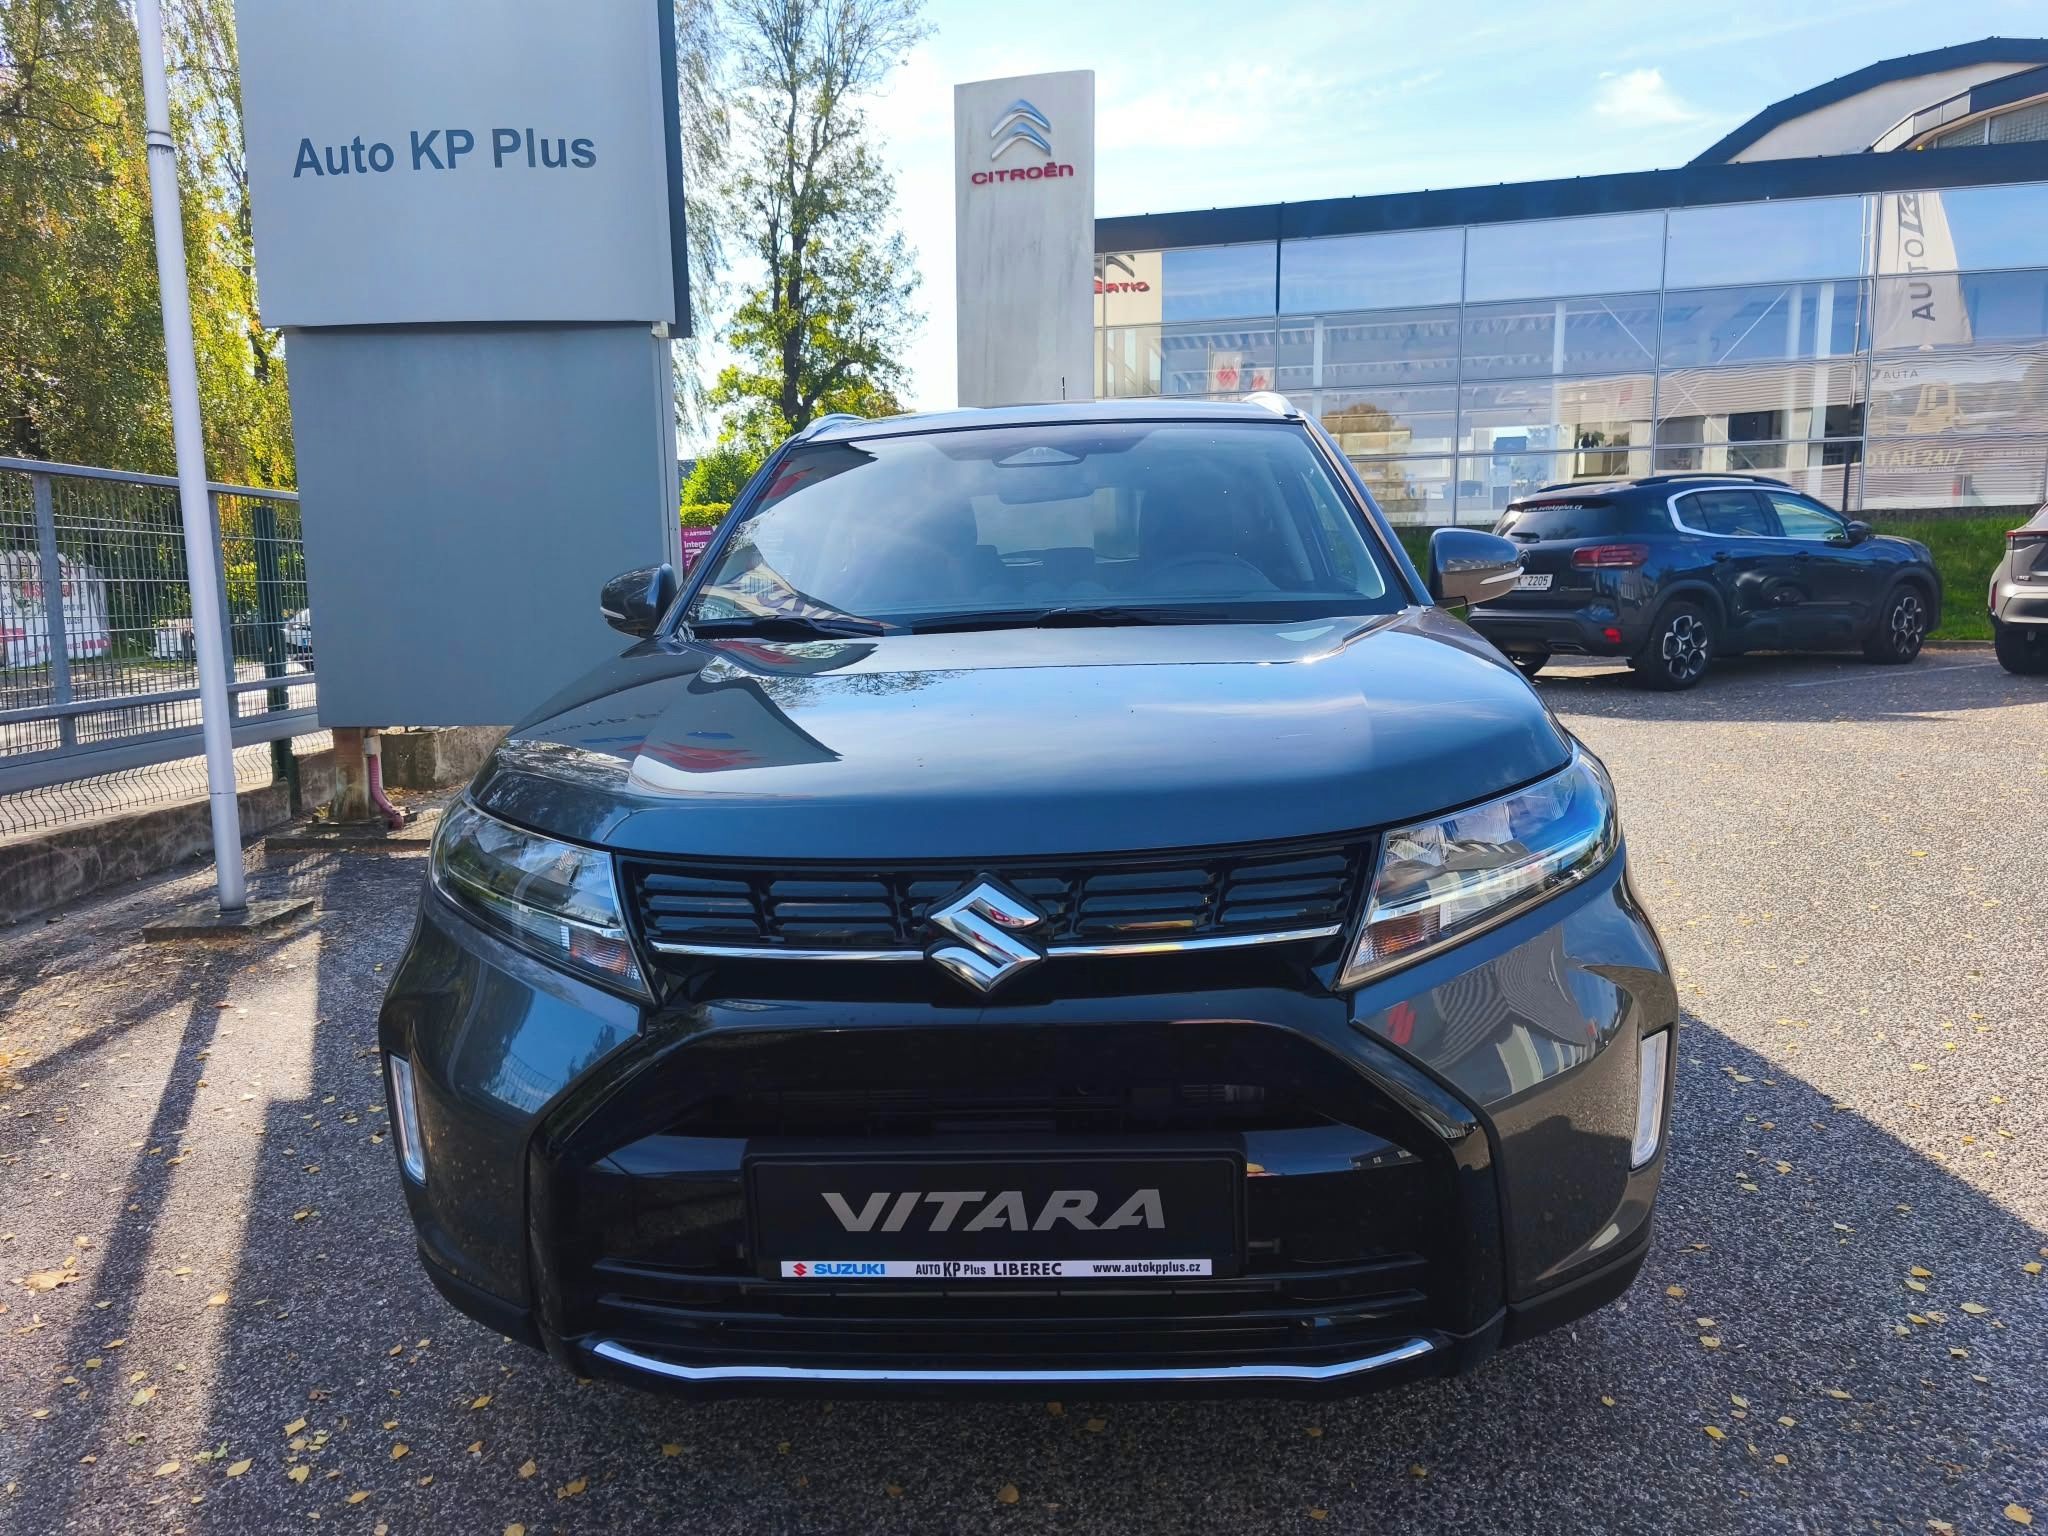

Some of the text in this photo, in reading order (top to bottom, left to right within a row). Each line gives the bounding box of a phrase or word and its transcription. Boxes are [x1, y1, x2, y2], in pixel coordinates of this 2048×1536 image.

[293, 128, 597, 178] Auto KP Plus
[971, 162, 1074, 185] CITROËN
[821, 1189, 1166, 1232] VITARA
[814, 1261, 1201, 1277] SUZUKI AUTO KP Plus LIBEREC www.autokpplus.cz
